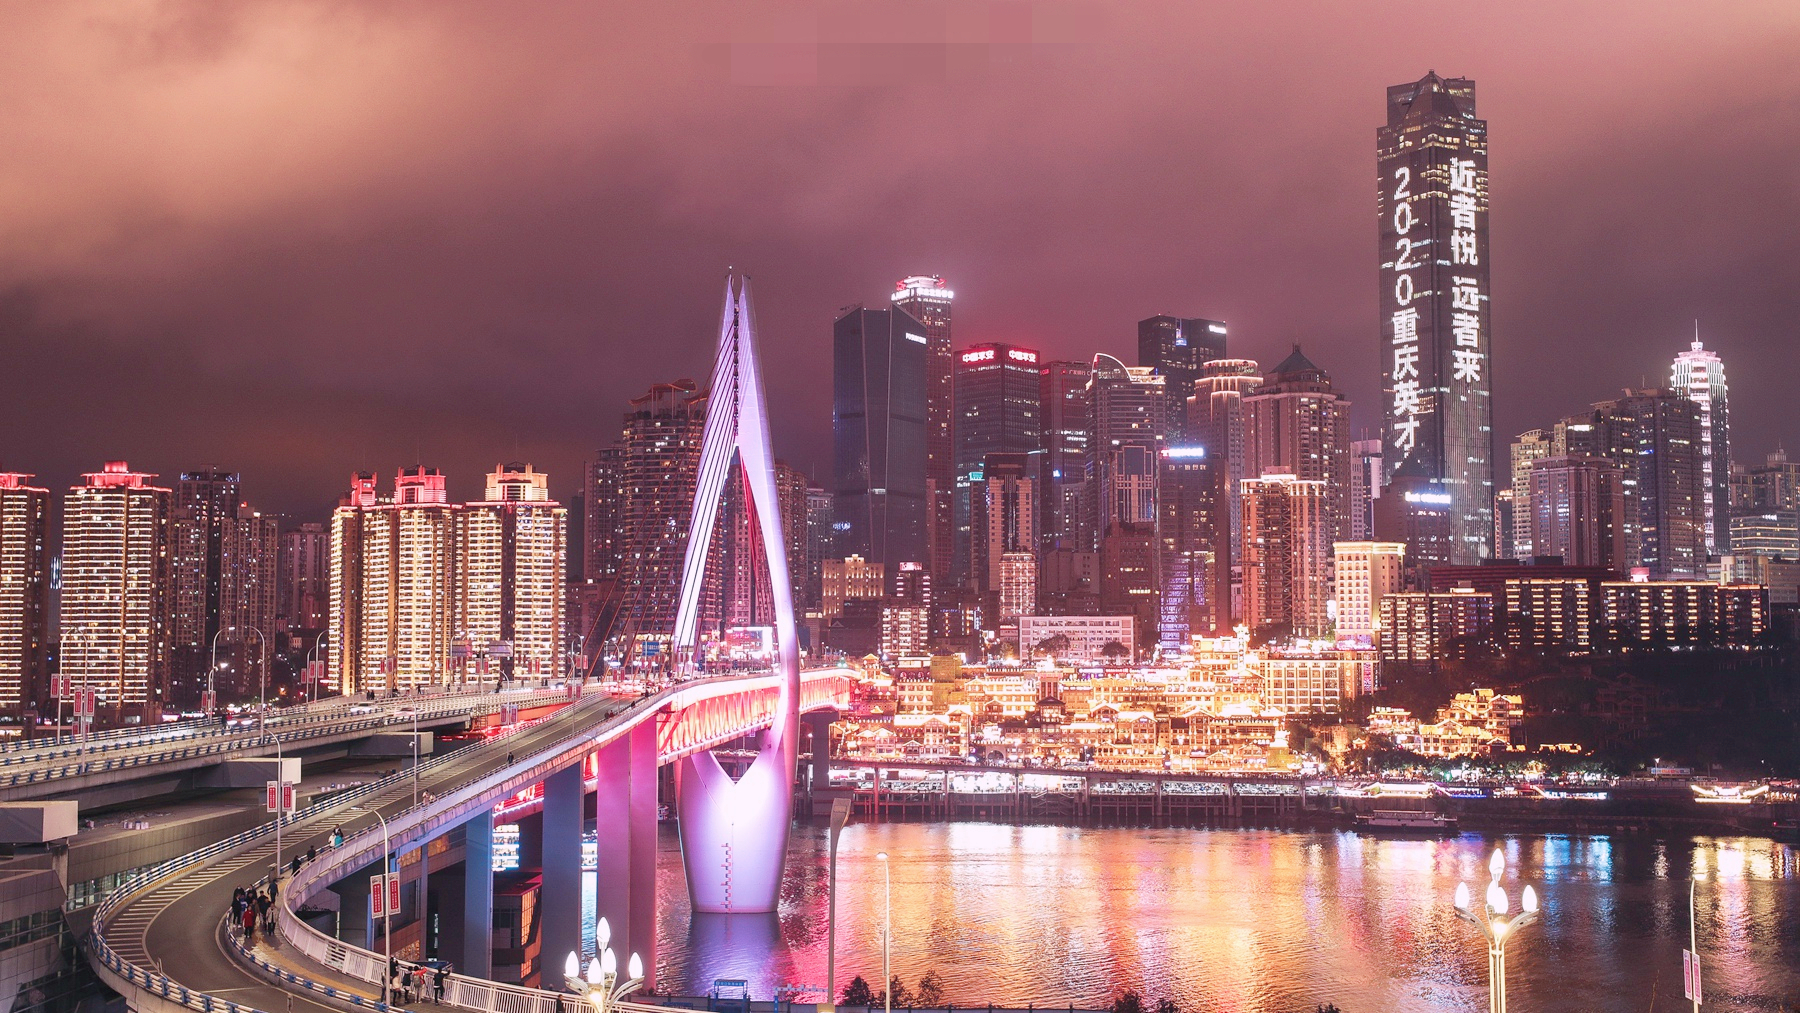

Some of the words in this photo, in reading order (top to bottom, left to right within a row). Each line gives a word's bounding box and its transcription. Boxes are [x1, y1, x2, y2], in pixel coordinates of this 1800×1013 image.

[1450, 157, 1478, 265] 近者悦
[1392, 167, 1419, 468] 2020重庆英才
[1452, 276, 1480, 383] 远者来
